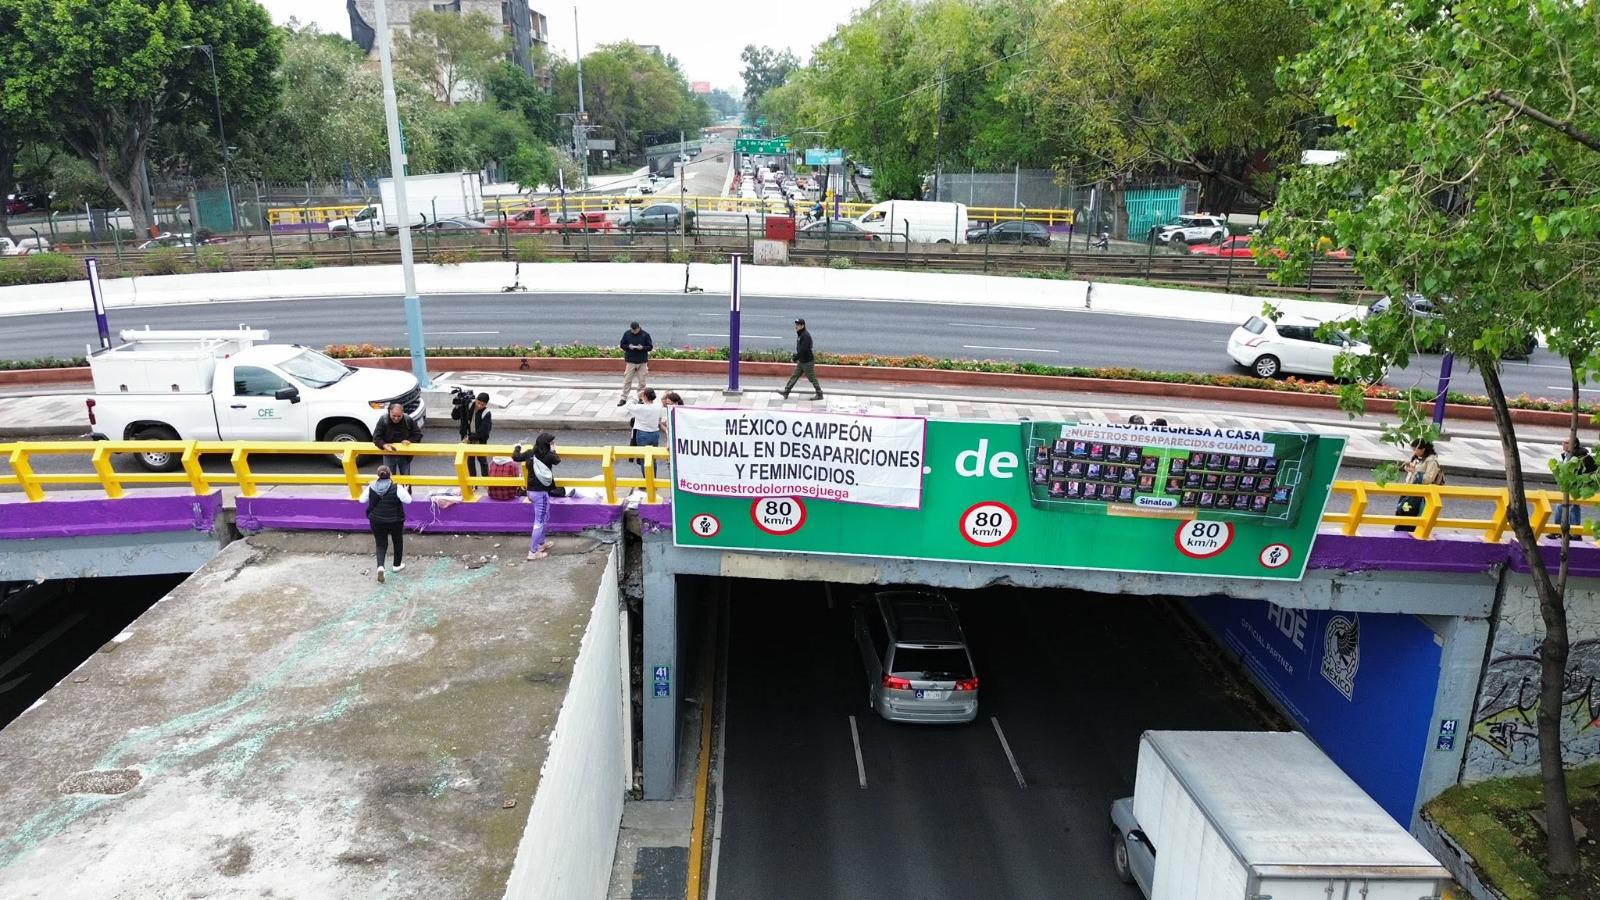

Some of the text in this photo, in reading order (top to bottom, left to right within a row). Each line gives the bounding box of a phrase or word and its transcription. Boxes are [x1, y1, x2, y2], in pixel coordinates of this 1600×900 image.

[258, 408, 274, 417] CFE
[725, 414, 873, 443] MÉXICO CAMPEÓN
[1214, 428, 1223, 438] A
[1226, 429, 1260, 441] CASA
[1066, 427, 1268, 453] ¿NUESTROS DESAPARECIDXS CUÁNDO?
[677, 438, 920, 468] MUNDIAL EN DESAPARICIONES
[955, 438, 1019, 479] de
[735, 463, 859, 486] Y FEMINICIDIOS.
[680, 478, 849, 500] #connuestrodolornosejuega
[765, 501, 792, 516] 80
[1140, 497, 1172, 507] Sinaloa
[763, 516, 793, 525] km/h
[975, 512, 1003, 527] 80
[972, 527, 1002, 537] km/h
[1191, 522, 1220, 538] 80
[1187, 538, 1217, 548] km/h
[1266, 642, 1294, 675] PARTNER
[656, 667, 667, 677] 41
[1443, 720, 1455, 730] 41
